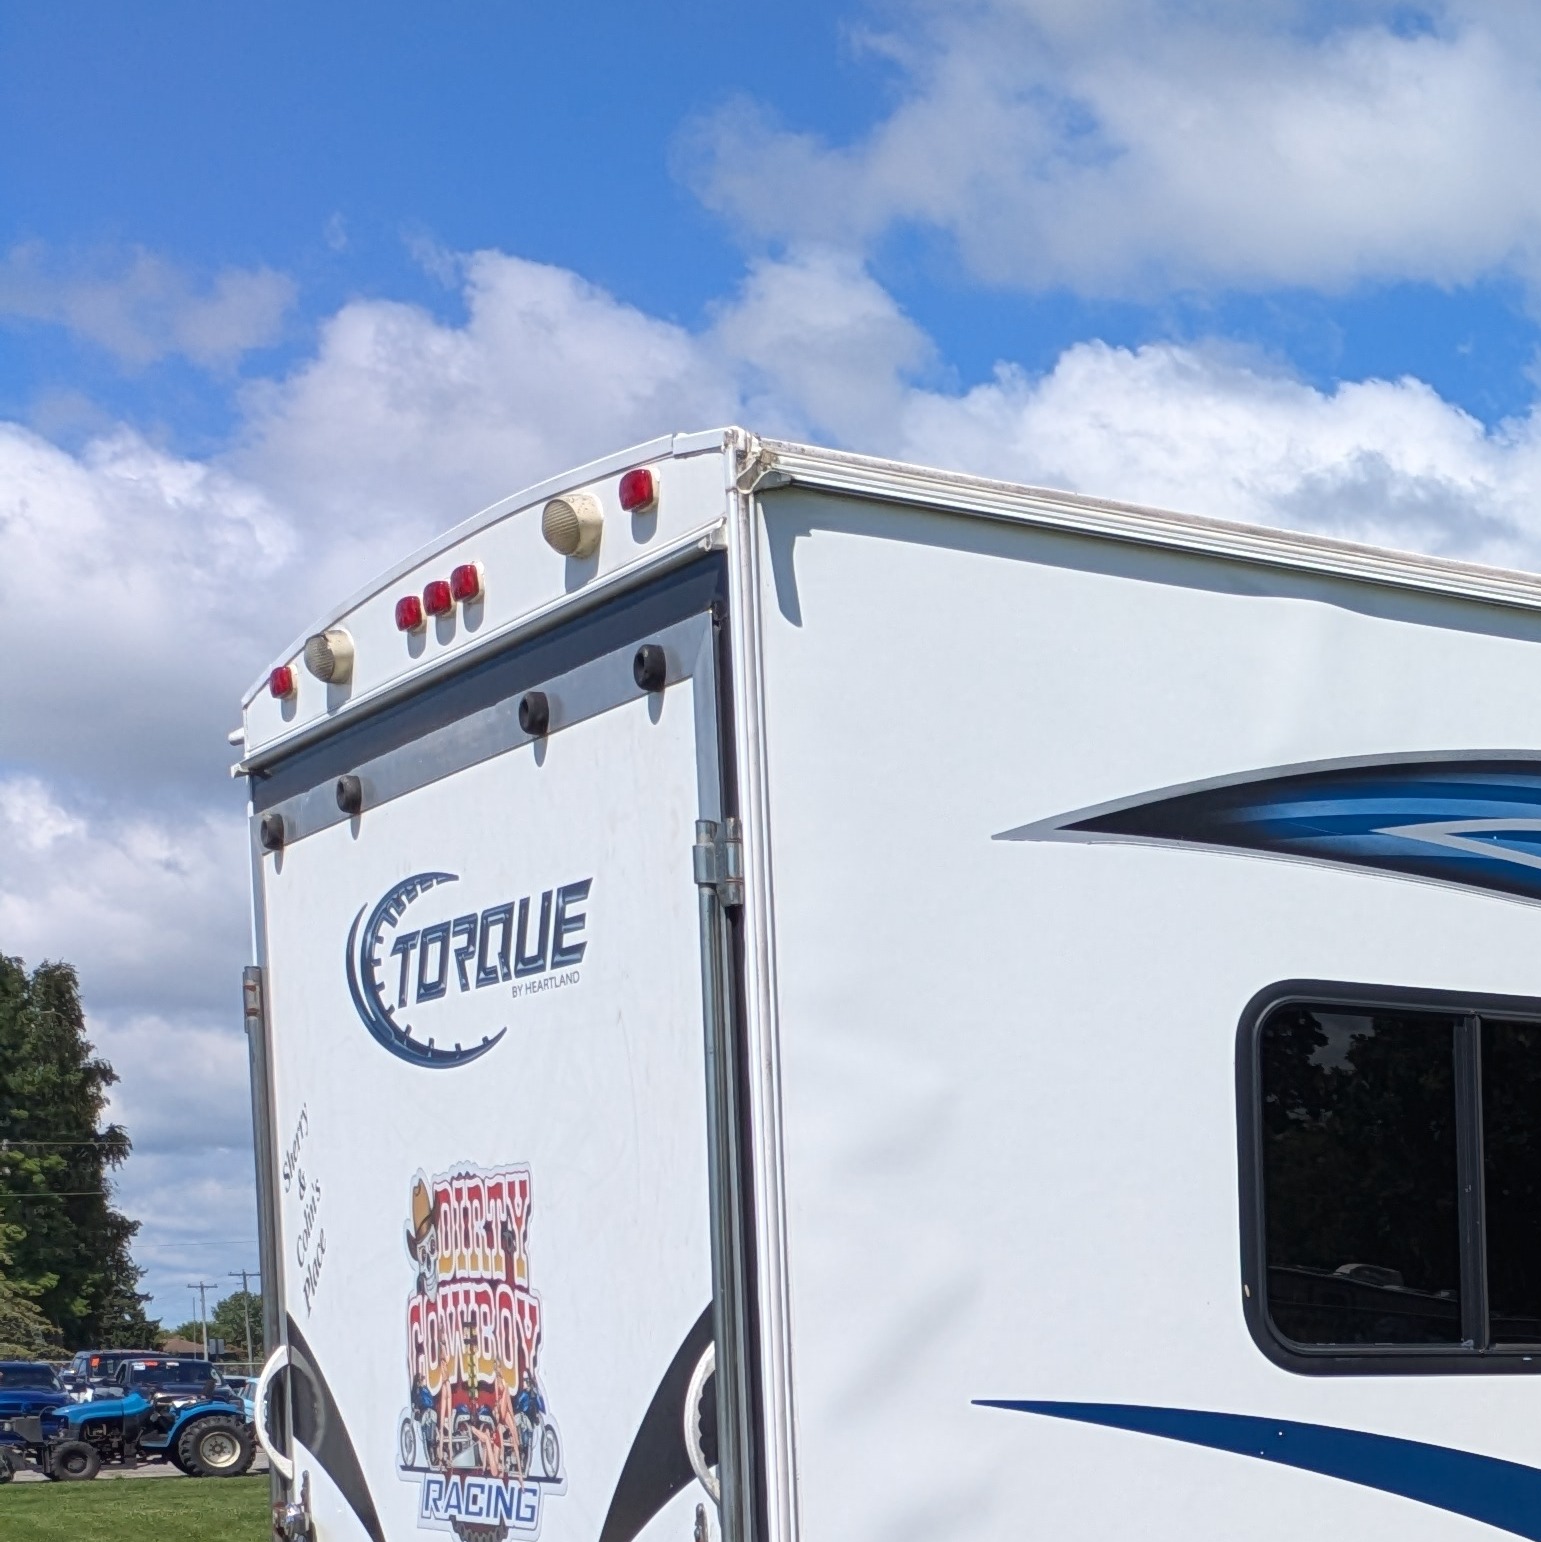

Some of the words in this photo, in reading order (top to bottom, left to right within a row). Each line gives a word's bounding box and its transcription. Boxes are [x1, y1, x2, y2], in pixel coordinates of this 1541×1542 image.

[390, 877, 594, 1010] TORQUE
[512, 985, 524, 998] BY
[525, 970, 580, 995] HEARTLAND
[283, 1102, 308, 1193] Sherry
[303, 1228, 326, 1320] Place
[433, 1171, 530, 1288] DIRTY
[408, 1283, 541, 1397] COWBOY
[424, 1478, 538, 1523] RACING
